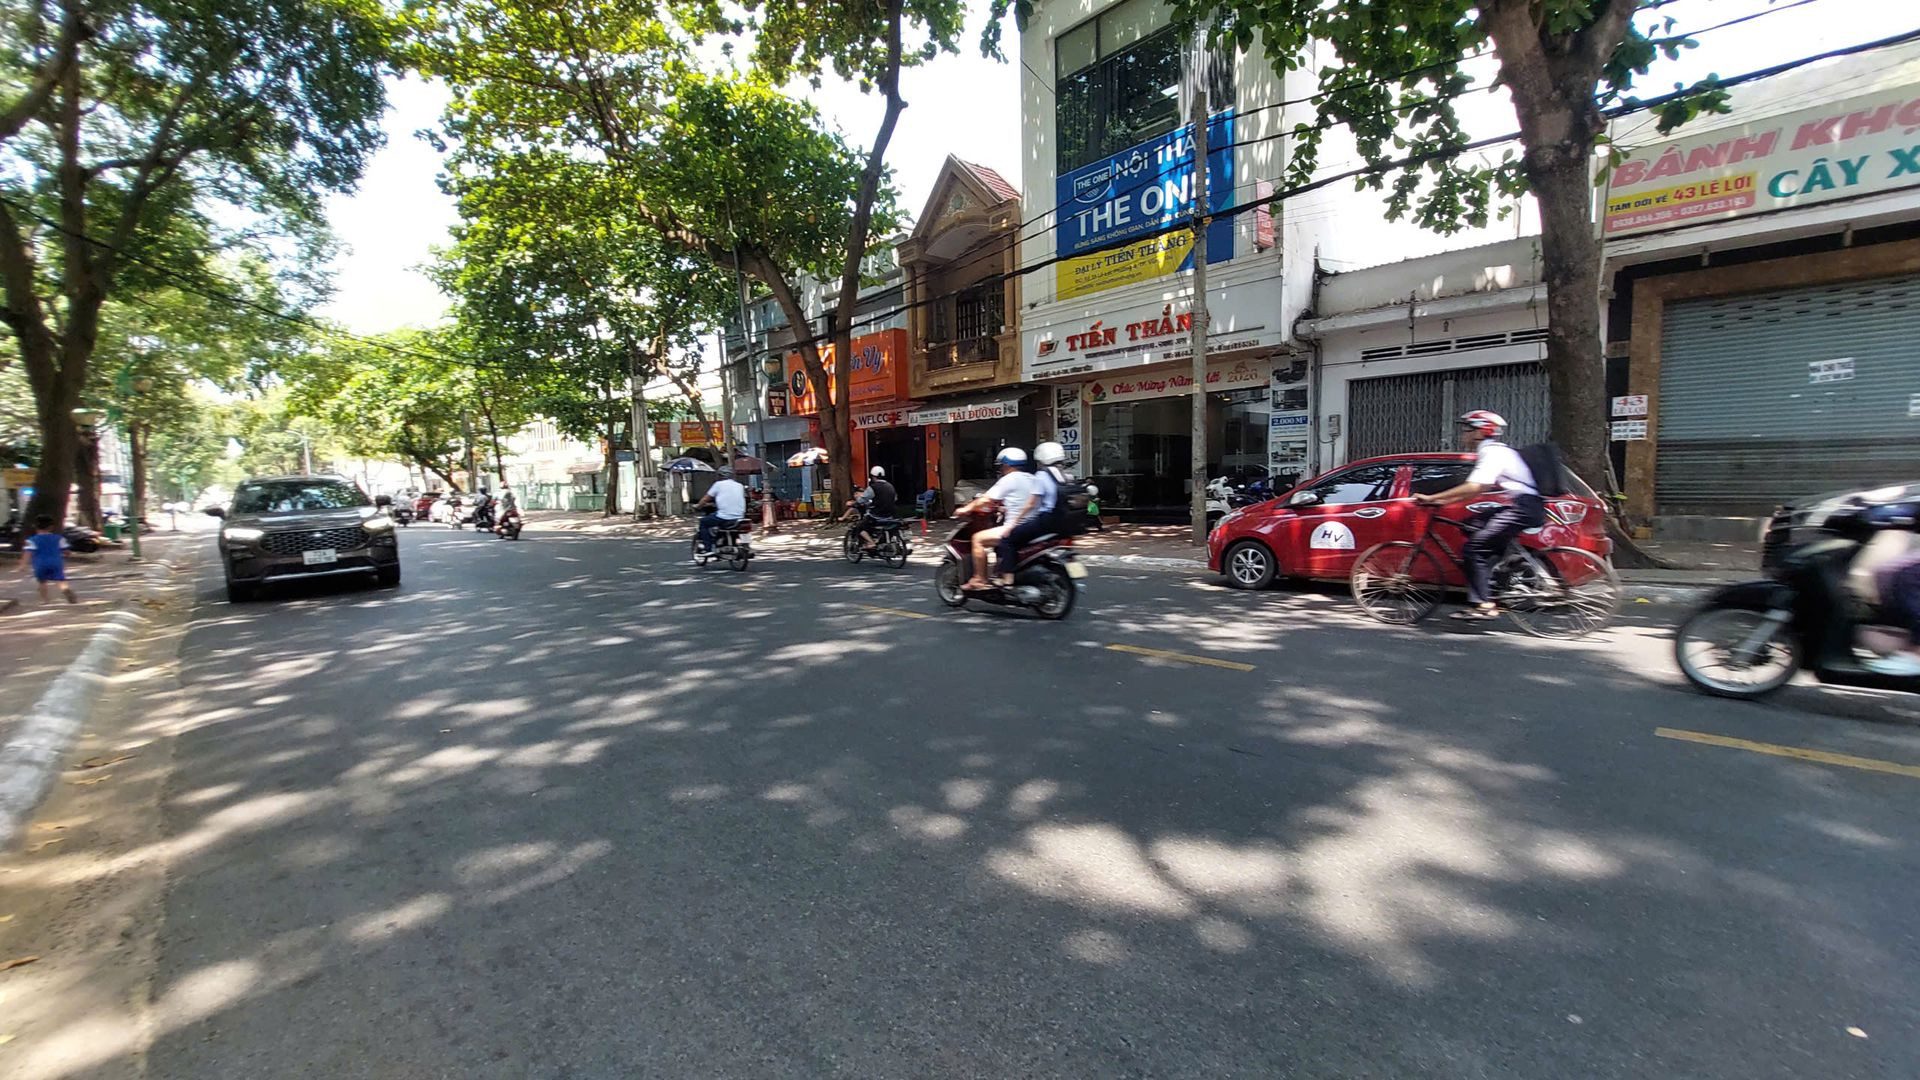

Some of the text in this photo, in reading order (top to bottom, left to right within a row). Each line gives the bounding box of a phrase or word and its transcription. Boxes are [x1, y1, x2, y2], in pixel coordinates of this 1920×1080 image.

[1116, 150, 1148, 180] NỘI
[1611, 130, 1776, 188] BÁNH
[1076, 171, 1109, 190] THE ONE
[1767, 154, 1871, 198] CÂY
[1673, 186, 1696, 200] 43
[1074, 194, 1131, 237] THE
[1066, 320, 1118, 352] TIẾN
[1616, 397, 1644, 407] 43
[1060, 429, 1078, 445] 39
